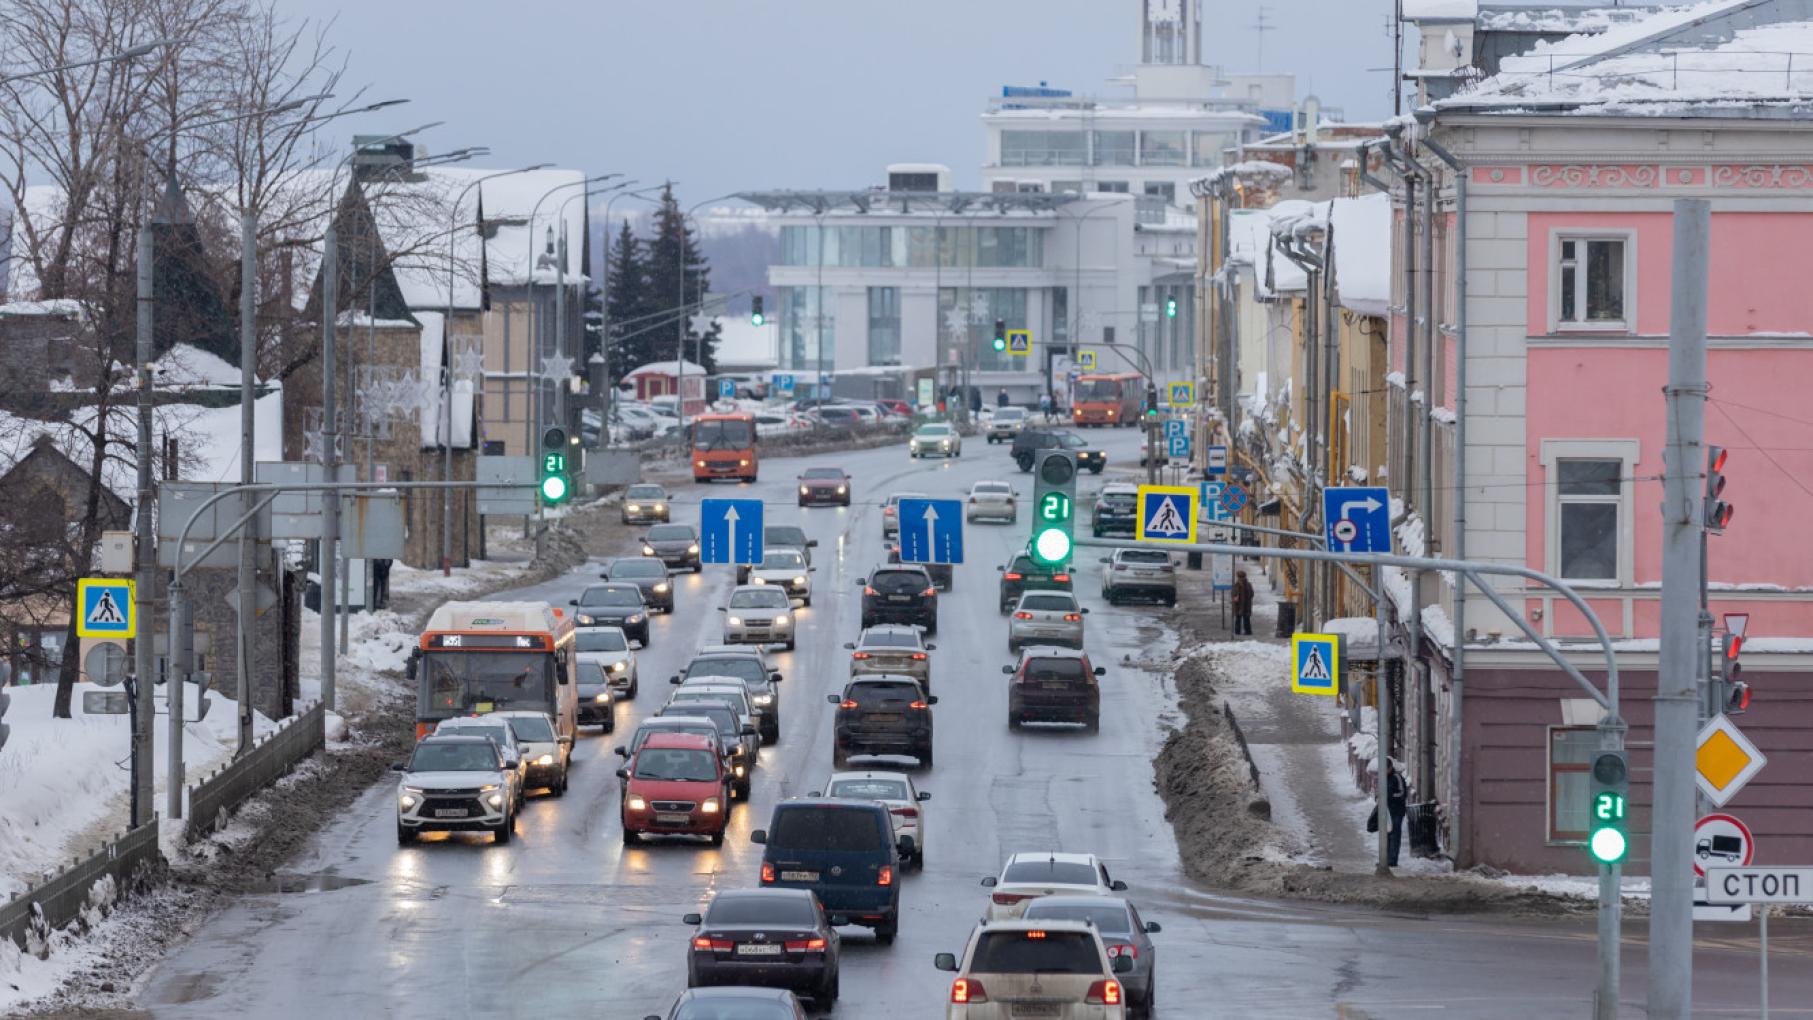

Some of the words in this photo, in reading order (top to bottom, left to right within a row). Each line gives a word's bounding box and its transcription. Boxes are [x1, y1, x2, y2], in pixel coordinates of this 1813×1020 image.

[722, 381, 732, 395] P
[1170, 422, 1180, 437] P
[1174, 439, 1185, 454] P
[546, 456, 563, 471] 21
[1206, 485, 1220, 504] P
[1044, 496, 1068, 519] 21
[1598, 796, 1623, 818] 21
[1723, 873, 1799, 897] СТОП
